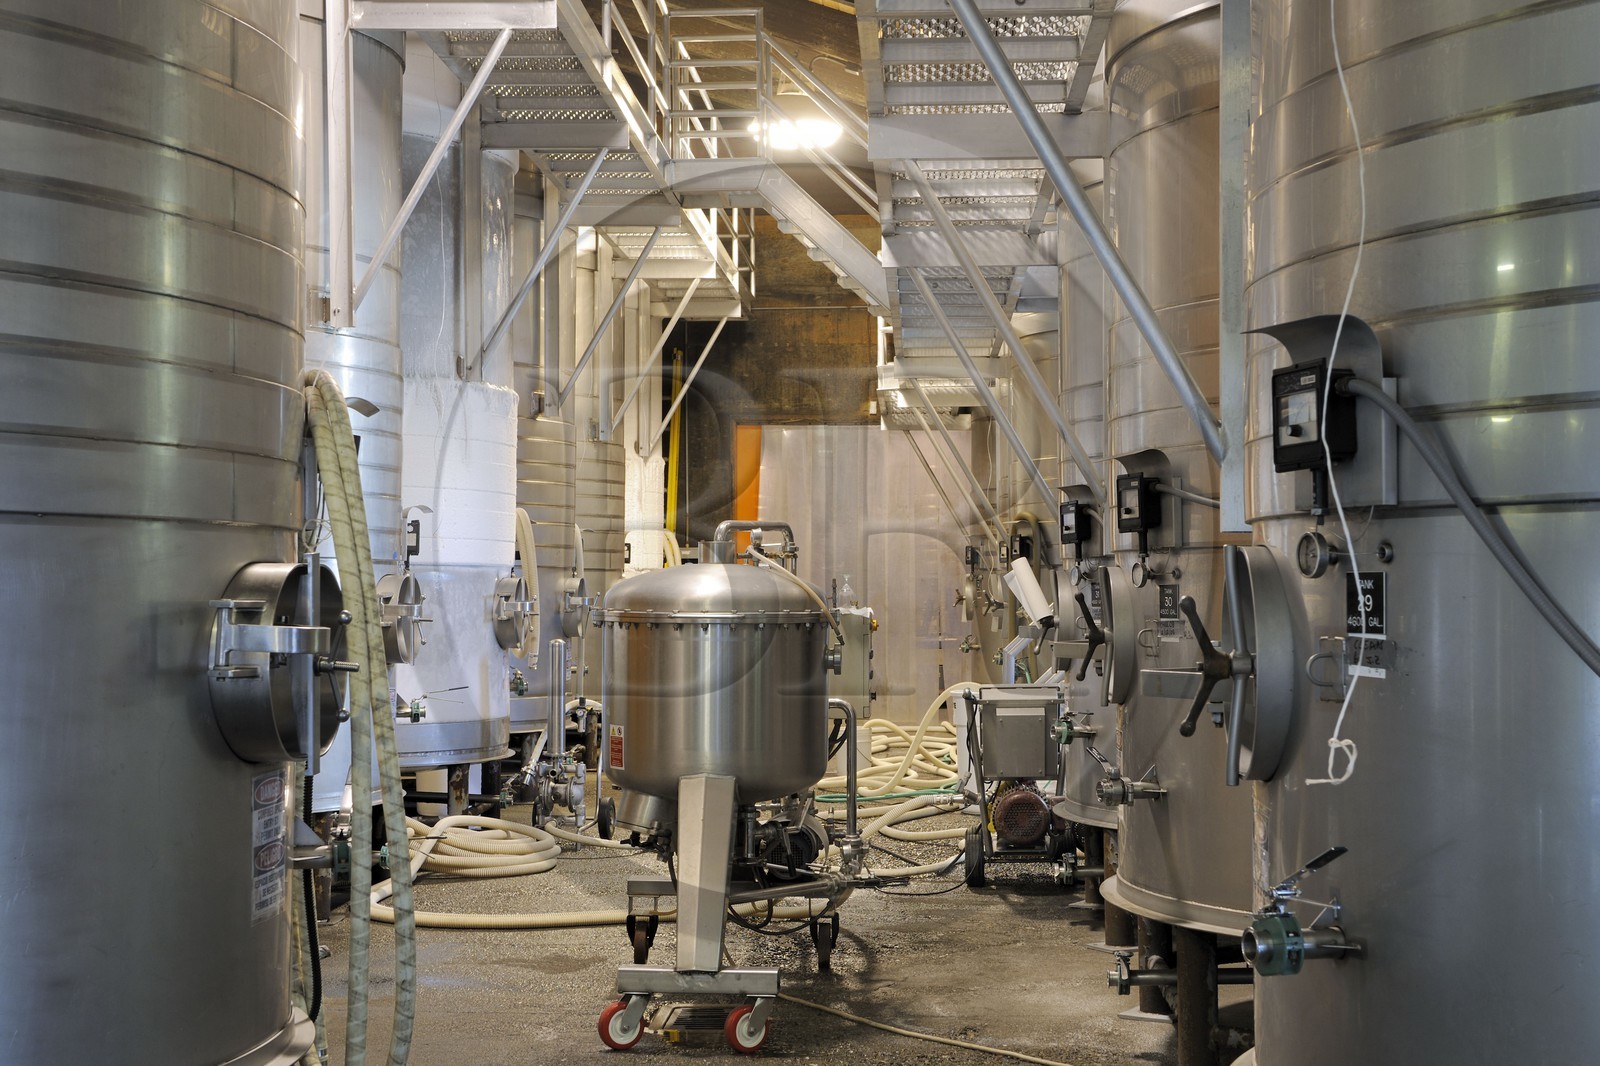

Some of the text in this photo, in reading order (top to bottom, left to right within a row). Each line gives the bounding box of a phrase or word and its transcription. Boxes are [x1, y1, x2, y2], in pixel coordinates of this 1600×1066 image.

[1356, 579, 1374, 590] ANK
[1164, 596, 1173, 607] 30
[1358, 594, 1373, 612] 29
